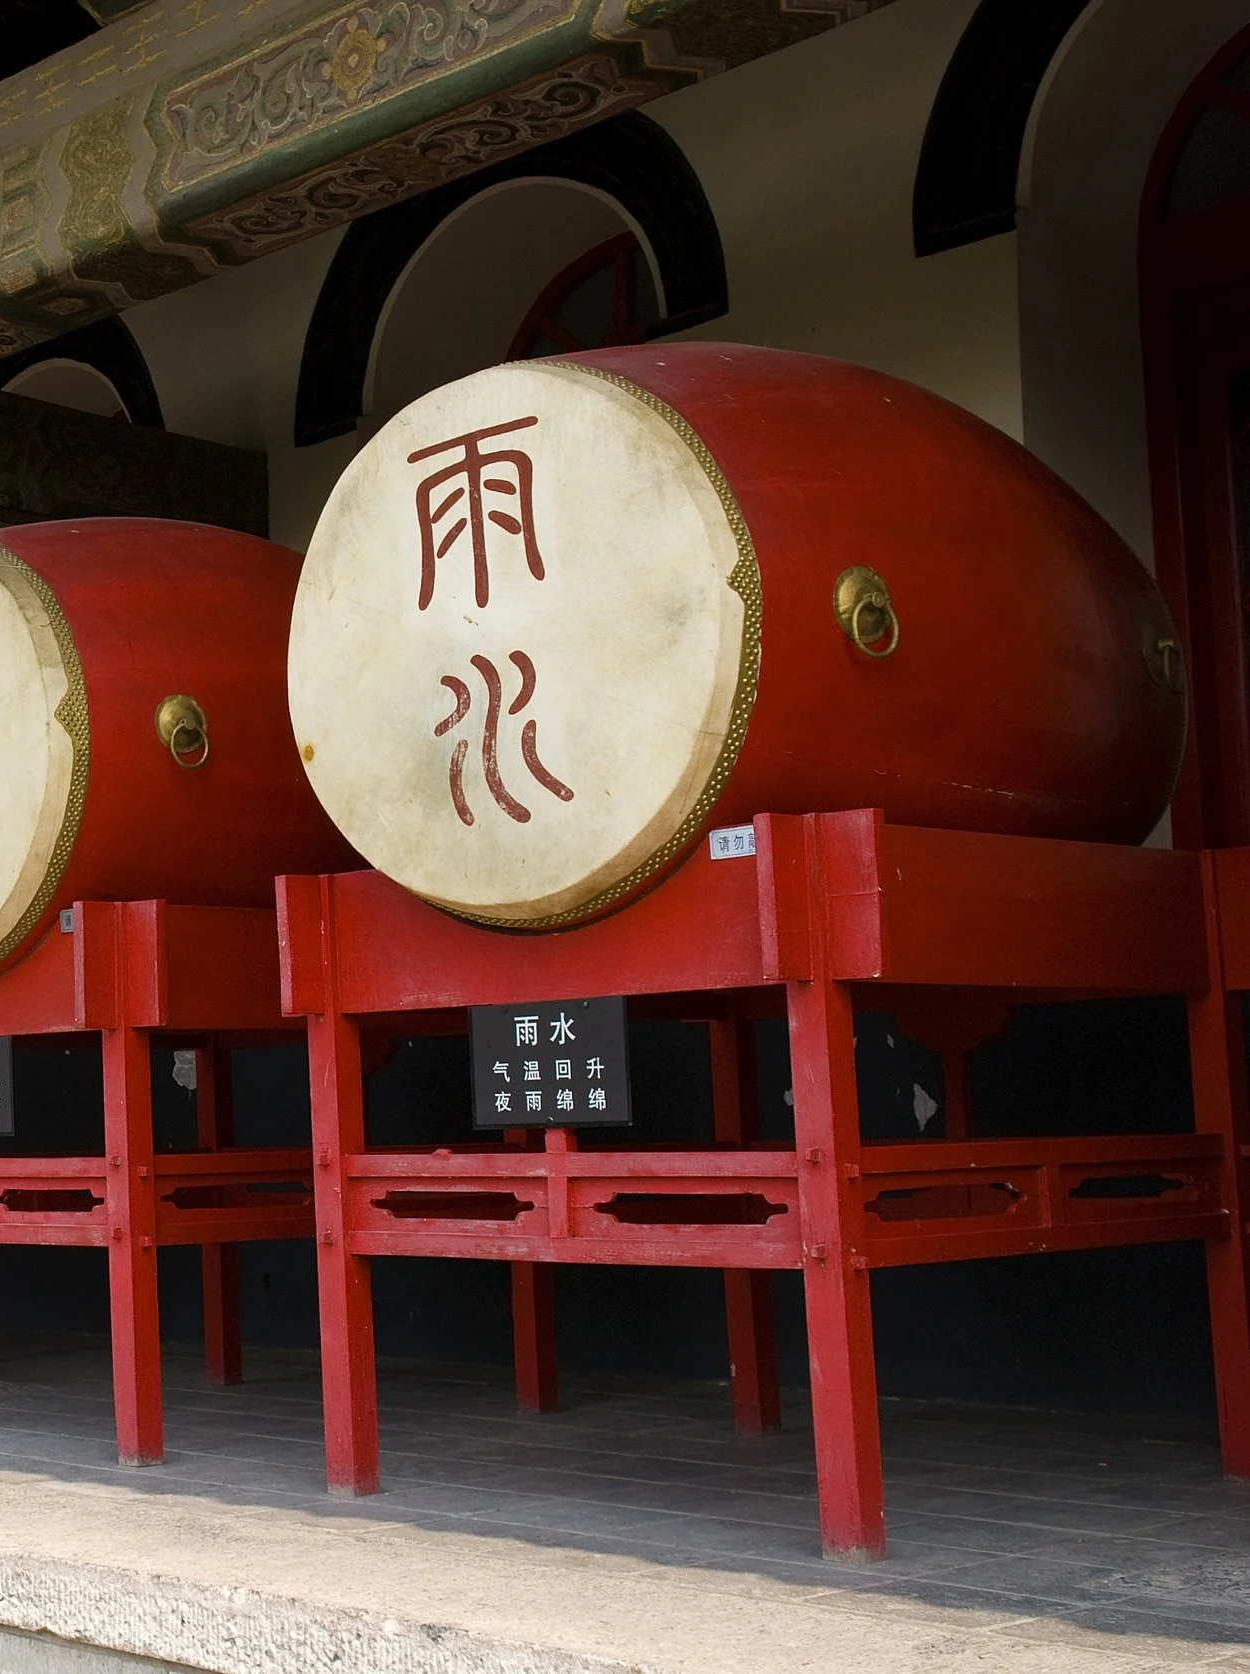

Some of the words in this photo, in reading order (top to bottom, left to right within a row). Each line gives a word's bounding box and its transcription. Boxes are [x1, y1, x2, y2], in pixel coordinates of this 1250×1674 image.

[406, 414, 575, 828] 雨水
[513, 1012, 577, 1047] 雨水
[492, 1056, 605, 1083] 气温回升
[494, 1087, 607, 1112] 夜雨绵绵
